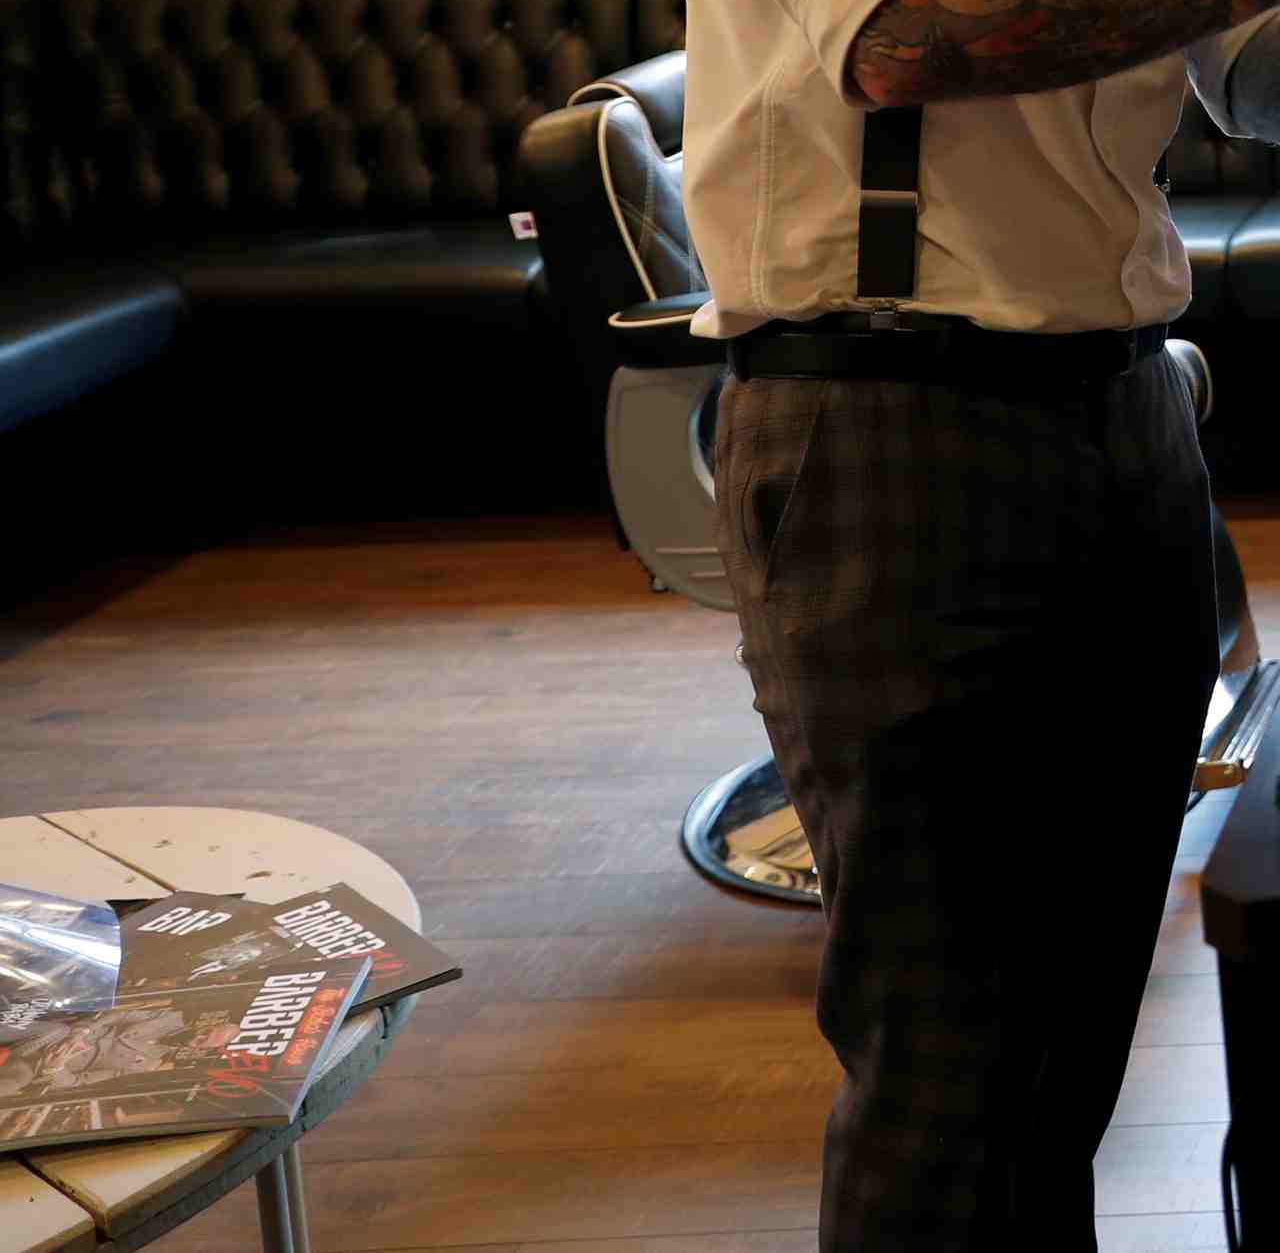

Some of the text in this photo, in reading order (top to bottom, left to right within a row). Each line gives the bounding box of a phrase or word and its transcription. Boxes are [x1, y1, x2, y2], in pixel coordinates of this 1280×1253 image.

[136, 907, 232, 936] BAR
[272, 899, 386, 959] BARBER
[226, 970, 327, 1056] BARBER
